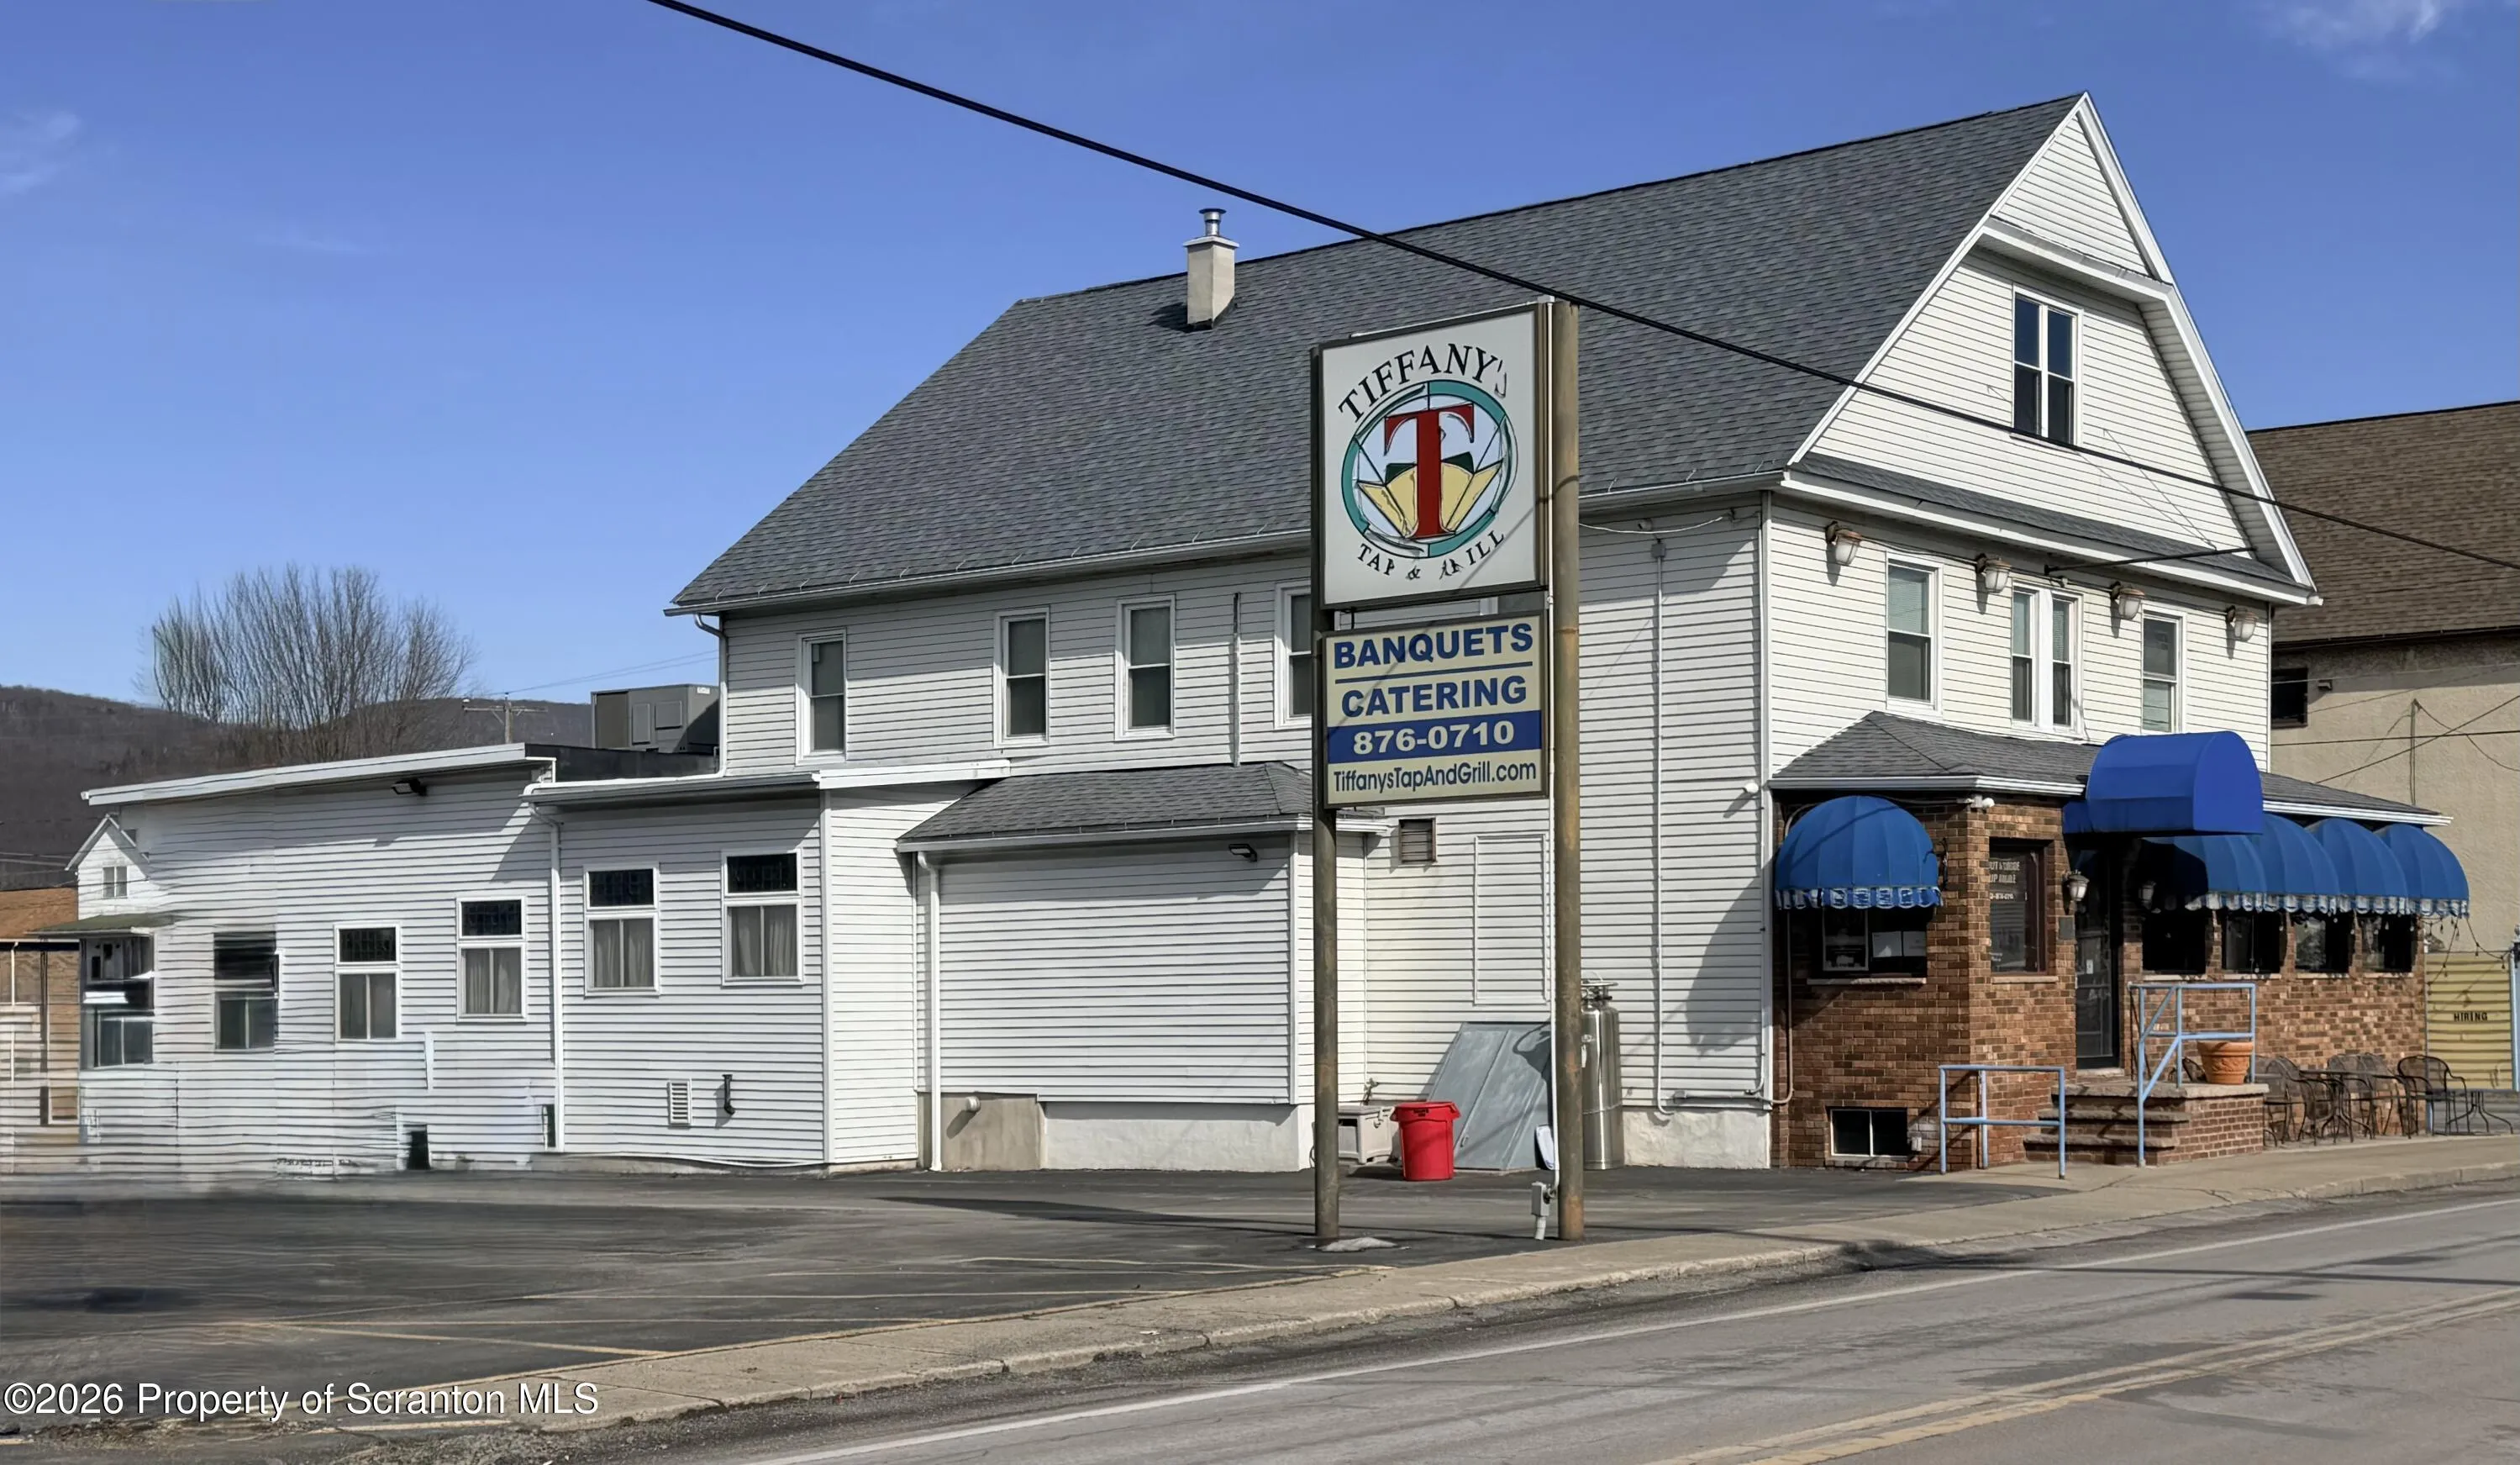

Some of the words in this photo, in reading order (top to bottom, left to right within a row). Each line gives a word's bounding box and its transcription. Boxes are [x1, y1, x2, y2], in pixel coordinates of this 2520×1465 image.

[1357, 543, 1396, 576] TAP
[1334, 623, 1534, 669] BANQUETS
[1342, 675, 1527, 717] CATERING
[1353, 720, 1514, 755] 876-0710
[1334, 761, 1536, 793] TiffanysTapAndGrill.com
[2454, 1012, 2488, 1021] HIRING
